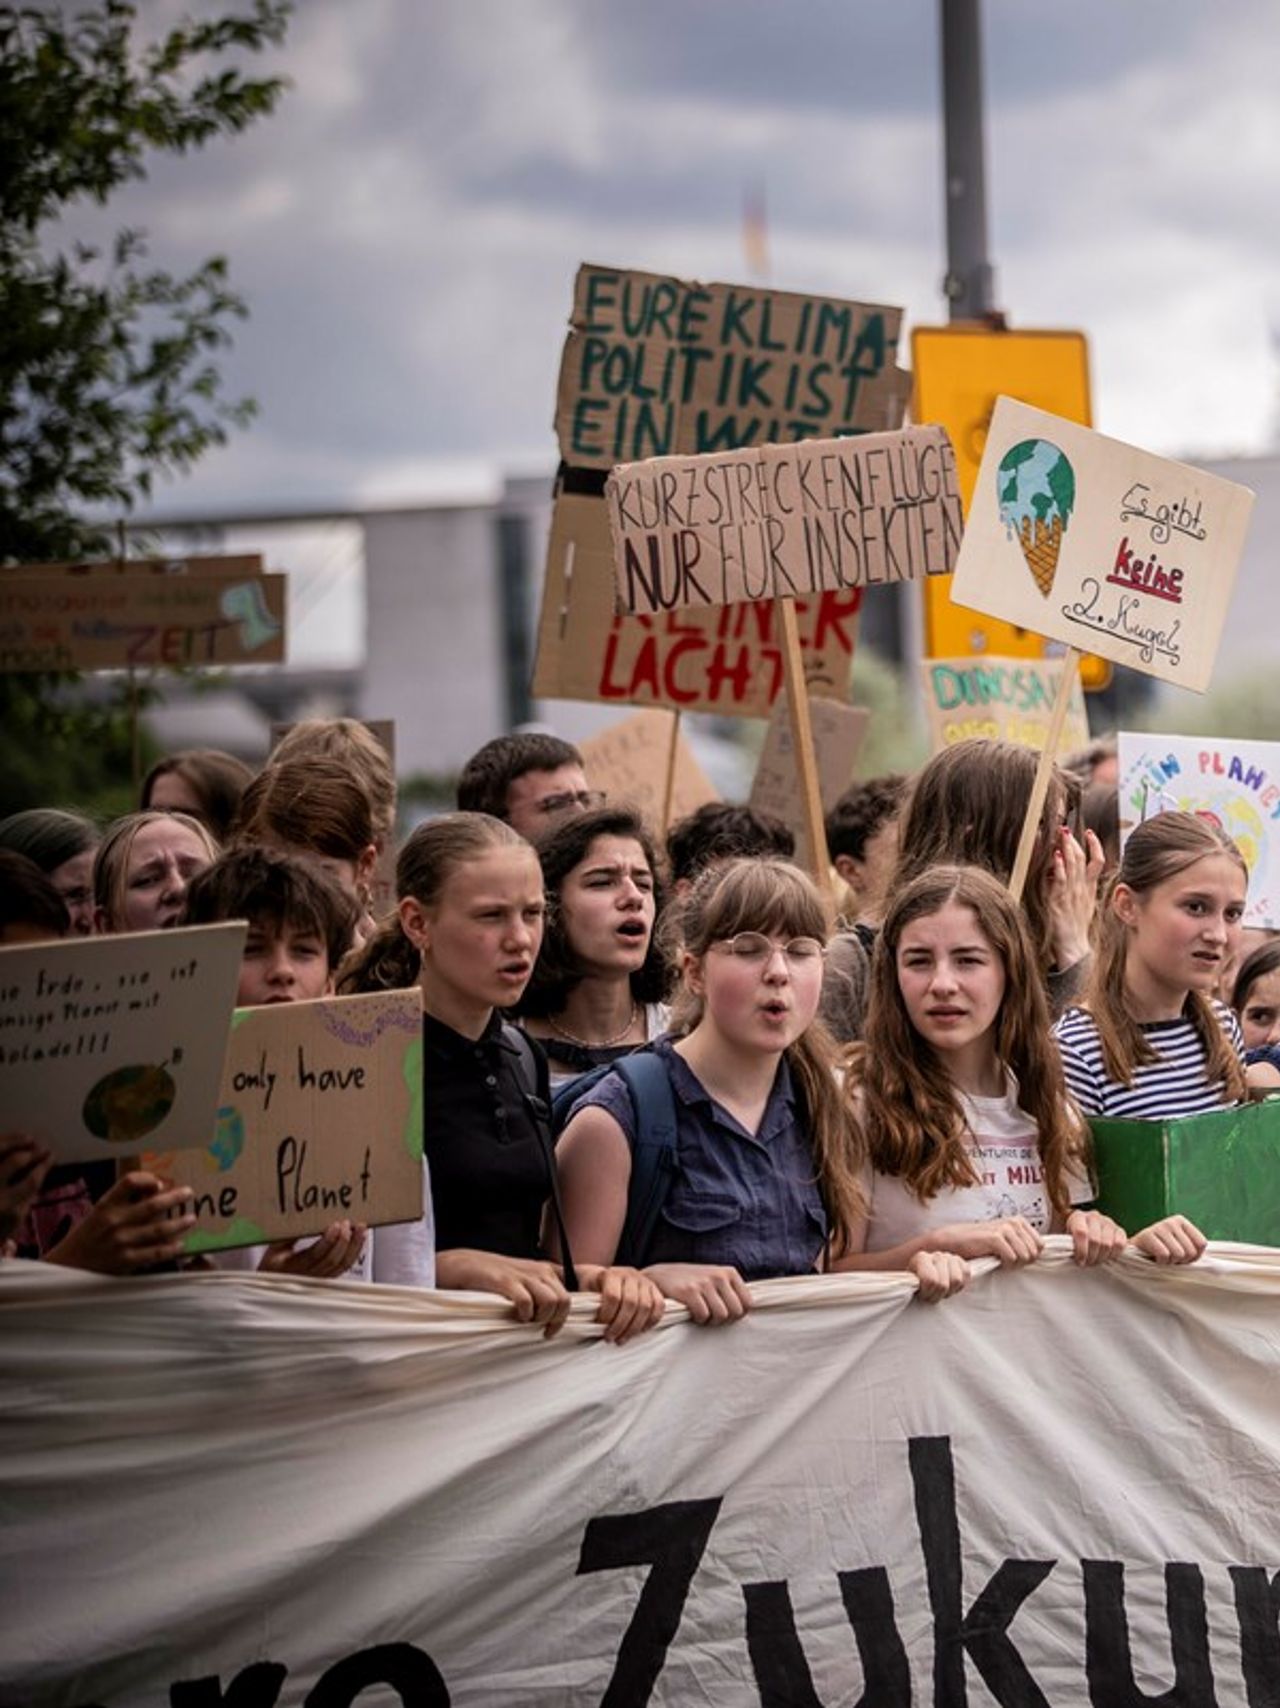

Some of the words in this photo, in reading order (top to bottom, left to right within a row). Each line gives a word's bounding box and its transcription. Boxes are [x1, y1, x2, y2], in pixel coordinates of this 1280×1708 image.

[586, 274, 711, 343] EURE
[580, 338, 772, 408] POLITIK
[786, 362, 881, 422] IST
[570, 397, 676, 460] EIN
[697, 409, 873, 453] WIT
[614, 441, 957, 531] KURZSTRECKENFLÜGE
[1121, 483, 1151, 512] Es
[1151, 496, 1204, 544] gibt
[623, 530, 711, 612] NUR
[718, 514, 798, 600] FÜR
[803, 495, 965, 594] INSEKTEN
[1113, 536, 1184, 595] keine
[127, 618, 240, 664] ZEIT
[1072, 577, 1105, 623] 2.
[1108, 594, 1182, 662] Kugel
[598, 633, 785, 708] LACHT
[118, 972, 151, 989] sie
[170, 959, 198, 981] ist
[128, 994, 161, 1012] mit
[233, 1048, 276, 1111] only
[298, 1045, 366, 1092] have
[277, 1136, 372, 1214] Planet
